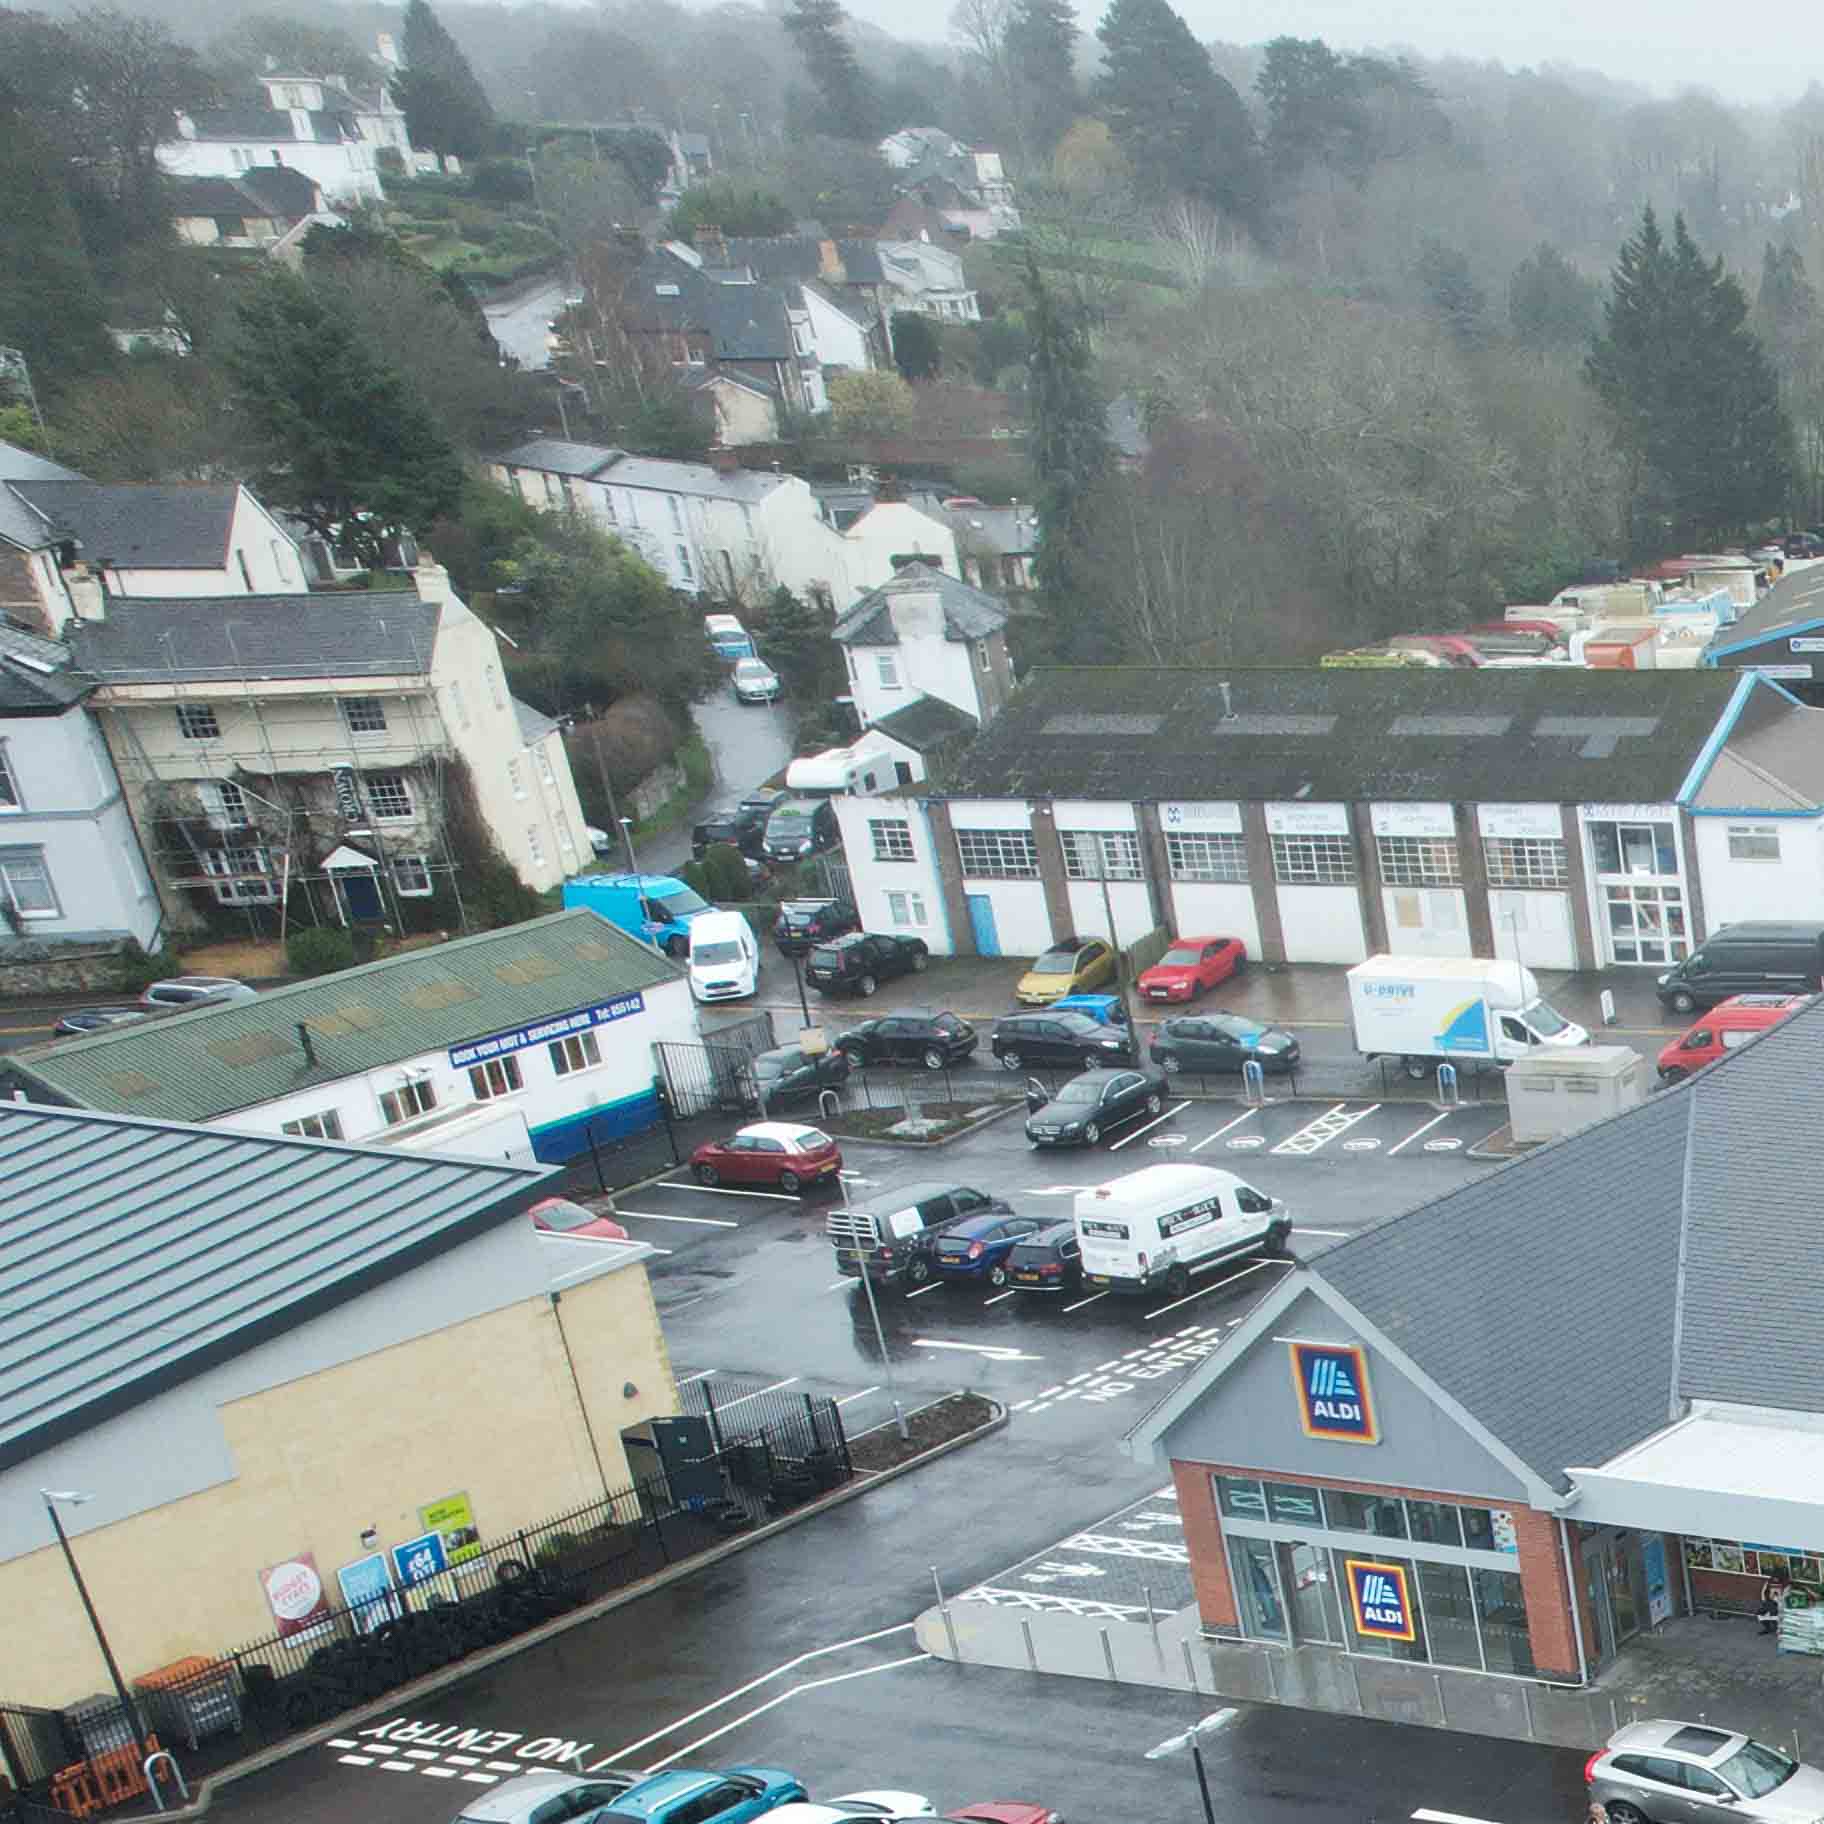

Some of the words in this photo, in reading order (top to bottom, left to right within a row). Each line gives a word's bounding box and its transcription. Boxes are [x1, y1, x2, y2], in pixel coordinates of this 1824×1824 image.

[1080, 1381, 1135, 1402] NO
[1314, 1399, 1361, 1421] ALDI
[1365, 1607, 1403, 1625] ALDI
[358, 1717, 523, 1755] ENTRY
[515, 1736, 595, 1763] NO
